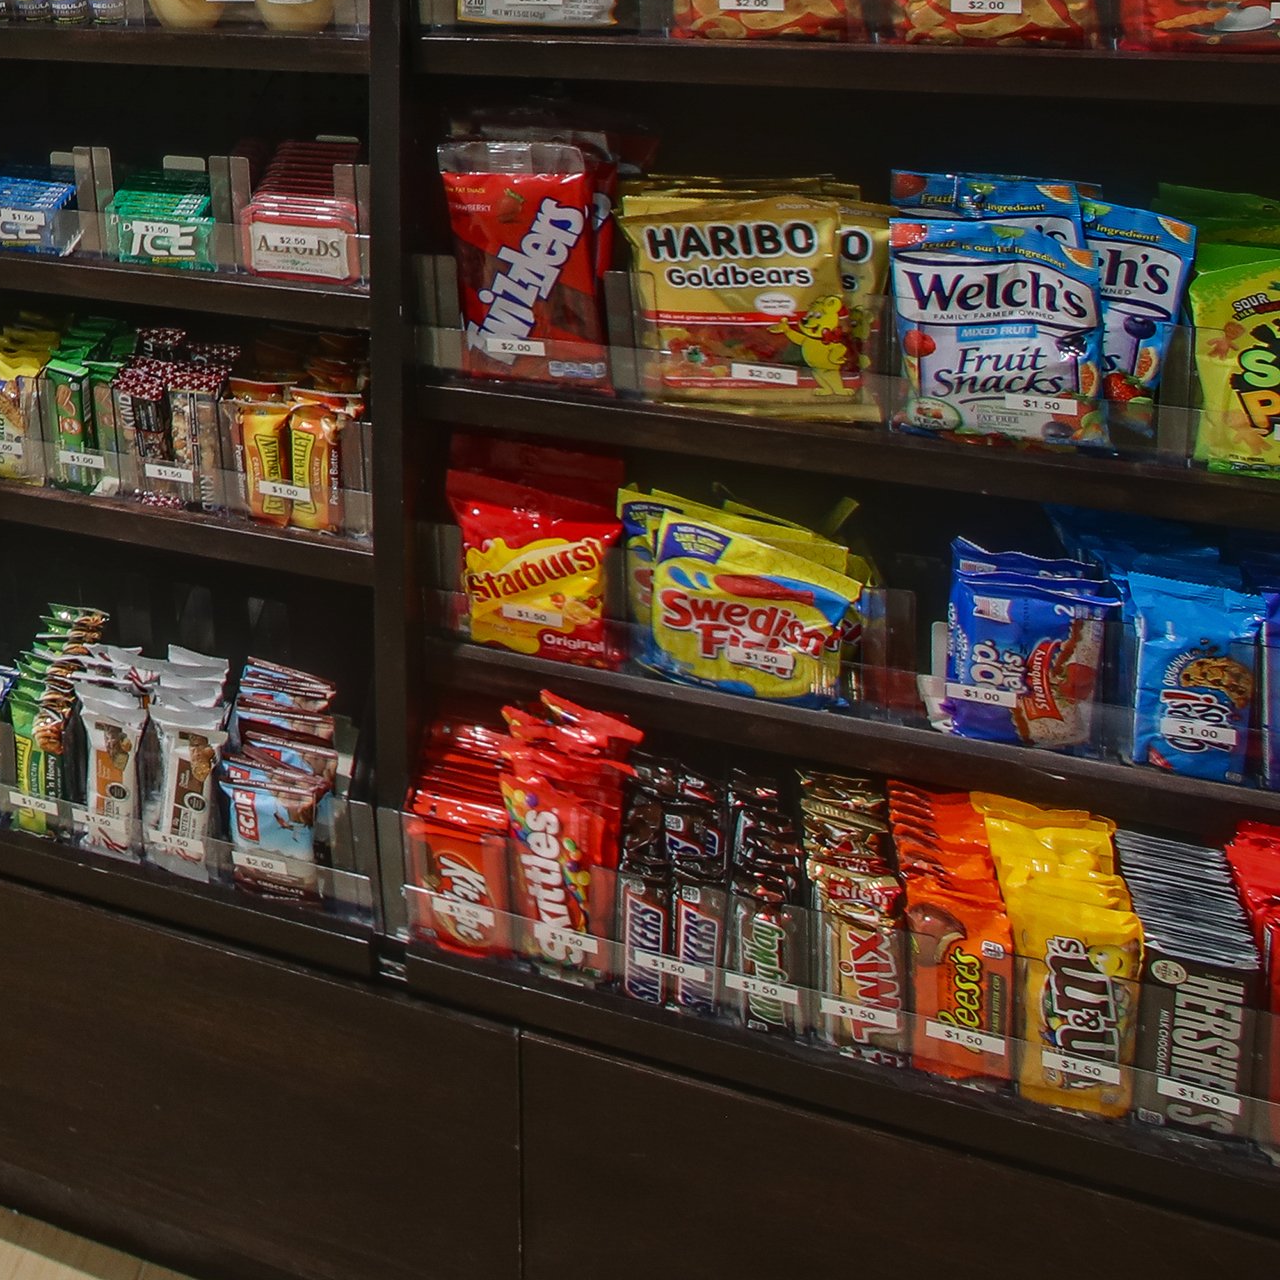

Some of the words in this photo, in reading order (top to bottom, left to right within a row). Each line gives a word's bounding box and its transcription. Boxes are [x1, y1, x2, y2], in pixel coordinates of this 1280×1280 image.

[967, 0, 1005, 10] $2.00
[12, 213, 35, 223] $1.50
[144, 224, 169, 235] $1.50
[279, 236, 306, 246] $2.50
[645, 221, 817, 262] HARIBO
[921, 241, 959, 251] Fruit
[1014, 247, 1067, 270] Ingredient!
[667, 266, 813, 289] Goldbears
[903, 270, 1088, 329] Welch's
[1232, 293, 1270, 313] SOUR
[933, 311, 971, 321] FAMILY
[973, 309, 1015, 319] FARMER
[1018, 309, 1055, 321] OWNED
[960, 327, 997, 338] MIXED
[999, 325, 1032, 337] FRUIT
[501, 342, 531, 353] $2.00
[957, 347, 1048, 375] Fruit
[748, 369, 781, 380] $2.00
[932, 369, 1065, 398] Snacks
[123, 392, 137, 431] KIND
[1022, 398, 1061, 411] $1.50
[69, 454, 94, 466] $1.00
[330, 448, 339, 476] Butter
[157, 468, 182, 480] $1.50
[271, 487, 298, 498] $1.00
[329, 477, 339, 506] Peanut
[467, 538, 602, 604] Starburst
[517, 610, 547, 623] $1.50
[543, 632, 605, 653] Original
[744, 652, 778, 665] $1.50
[1161, 650, 1195, 687] ORIGINAL
[1030, 648, 1051, 713] Strawberry
[963, 688, 1000, 703] $1.00
[1178, 724, 1218, 740] $1.00
[22, 797, 46, 809] $1.00
[85, 815, 112, 826] $1.50
[161, 836, 188, 848] $1.50
[244, 856, 274, 869] $2.00
[448, 904, 480, 919] $1.50
[549, 932, 583, 948] $1.50
[651, 958, 685, 974] $1.50
[742, 980, 778, 997] $1.50
[839, 1006, 876, 1021] $1.50
[944, 1030, 983, 1047] $1.50
[1061, 1060, 1101, 1077] $1.50
[1177, 1088, 1220, 1105] $1.50
